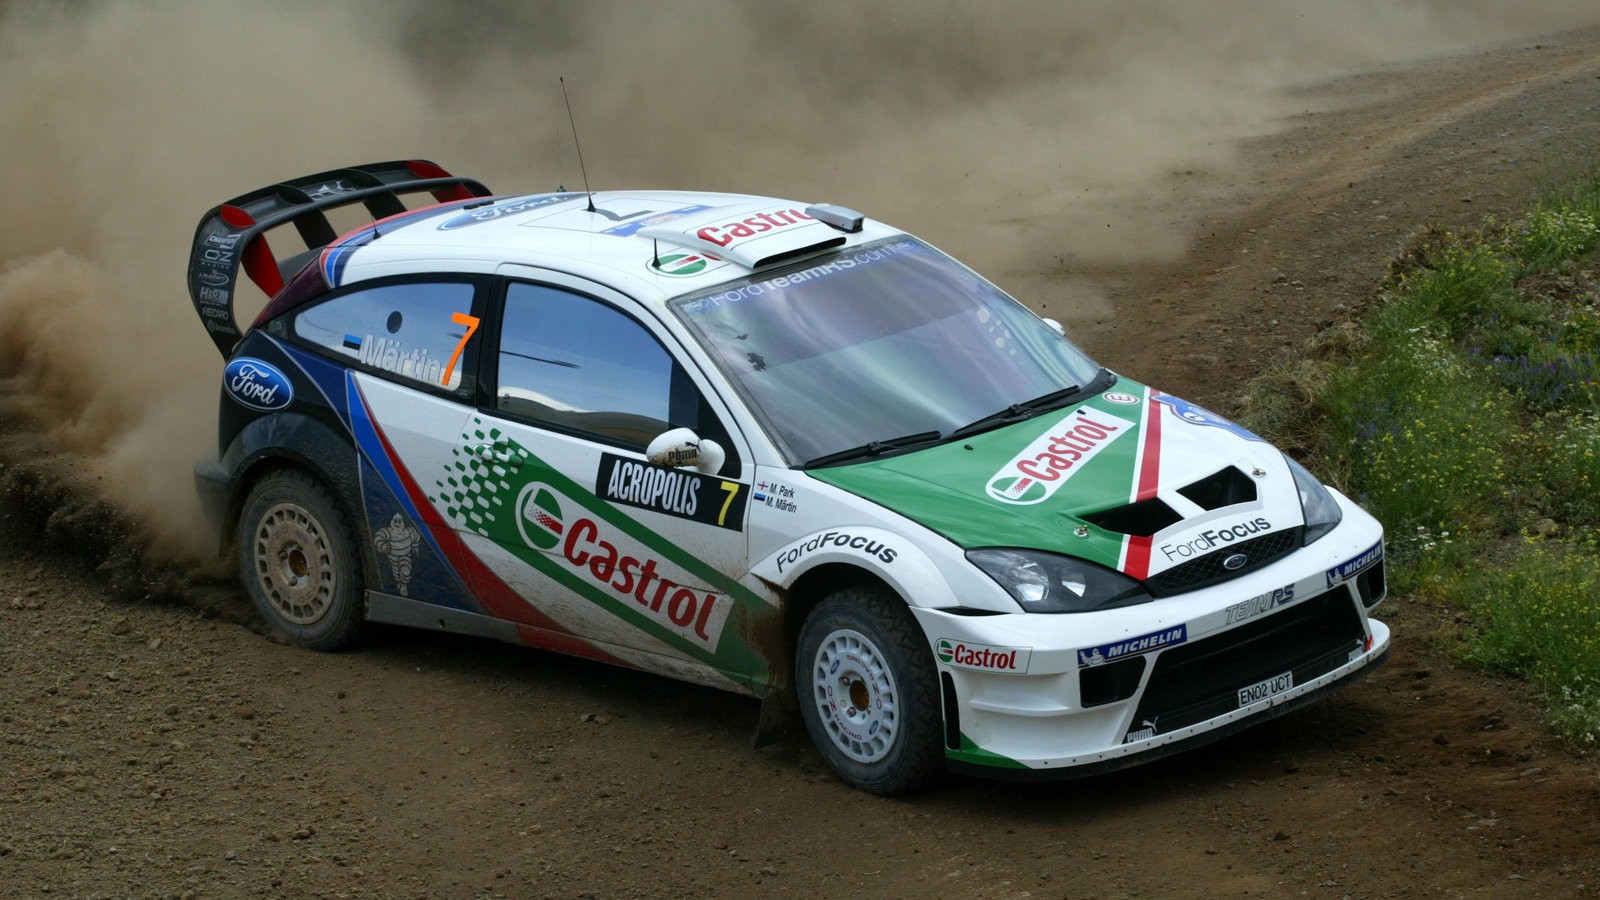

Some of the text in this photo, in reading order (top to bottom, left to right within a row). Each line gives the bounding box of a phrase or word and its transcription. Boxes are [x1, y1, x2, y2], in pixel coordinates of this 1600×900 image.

[361, 334, 442, 384] Märtin
[442, 312, 480, 386] 7
[231, 364, 279, 404] Ford
[1016, 416, 1118, 482] Castrol
[607, 459, 740, 526] ACROPOLIS 7
[765, 496, 797, 512] M. Märtin
[769, 483, 795, 498] M. Park
[1343, 543, 1383, 577] MICHELIN
[564, 518, 716, 642] Castrol
[954, 644, 1016, 670] Castrol
[1108, 628, 1183, 658] MICHELIN
[1240, 674, 1291, 705] EN02 UCT
